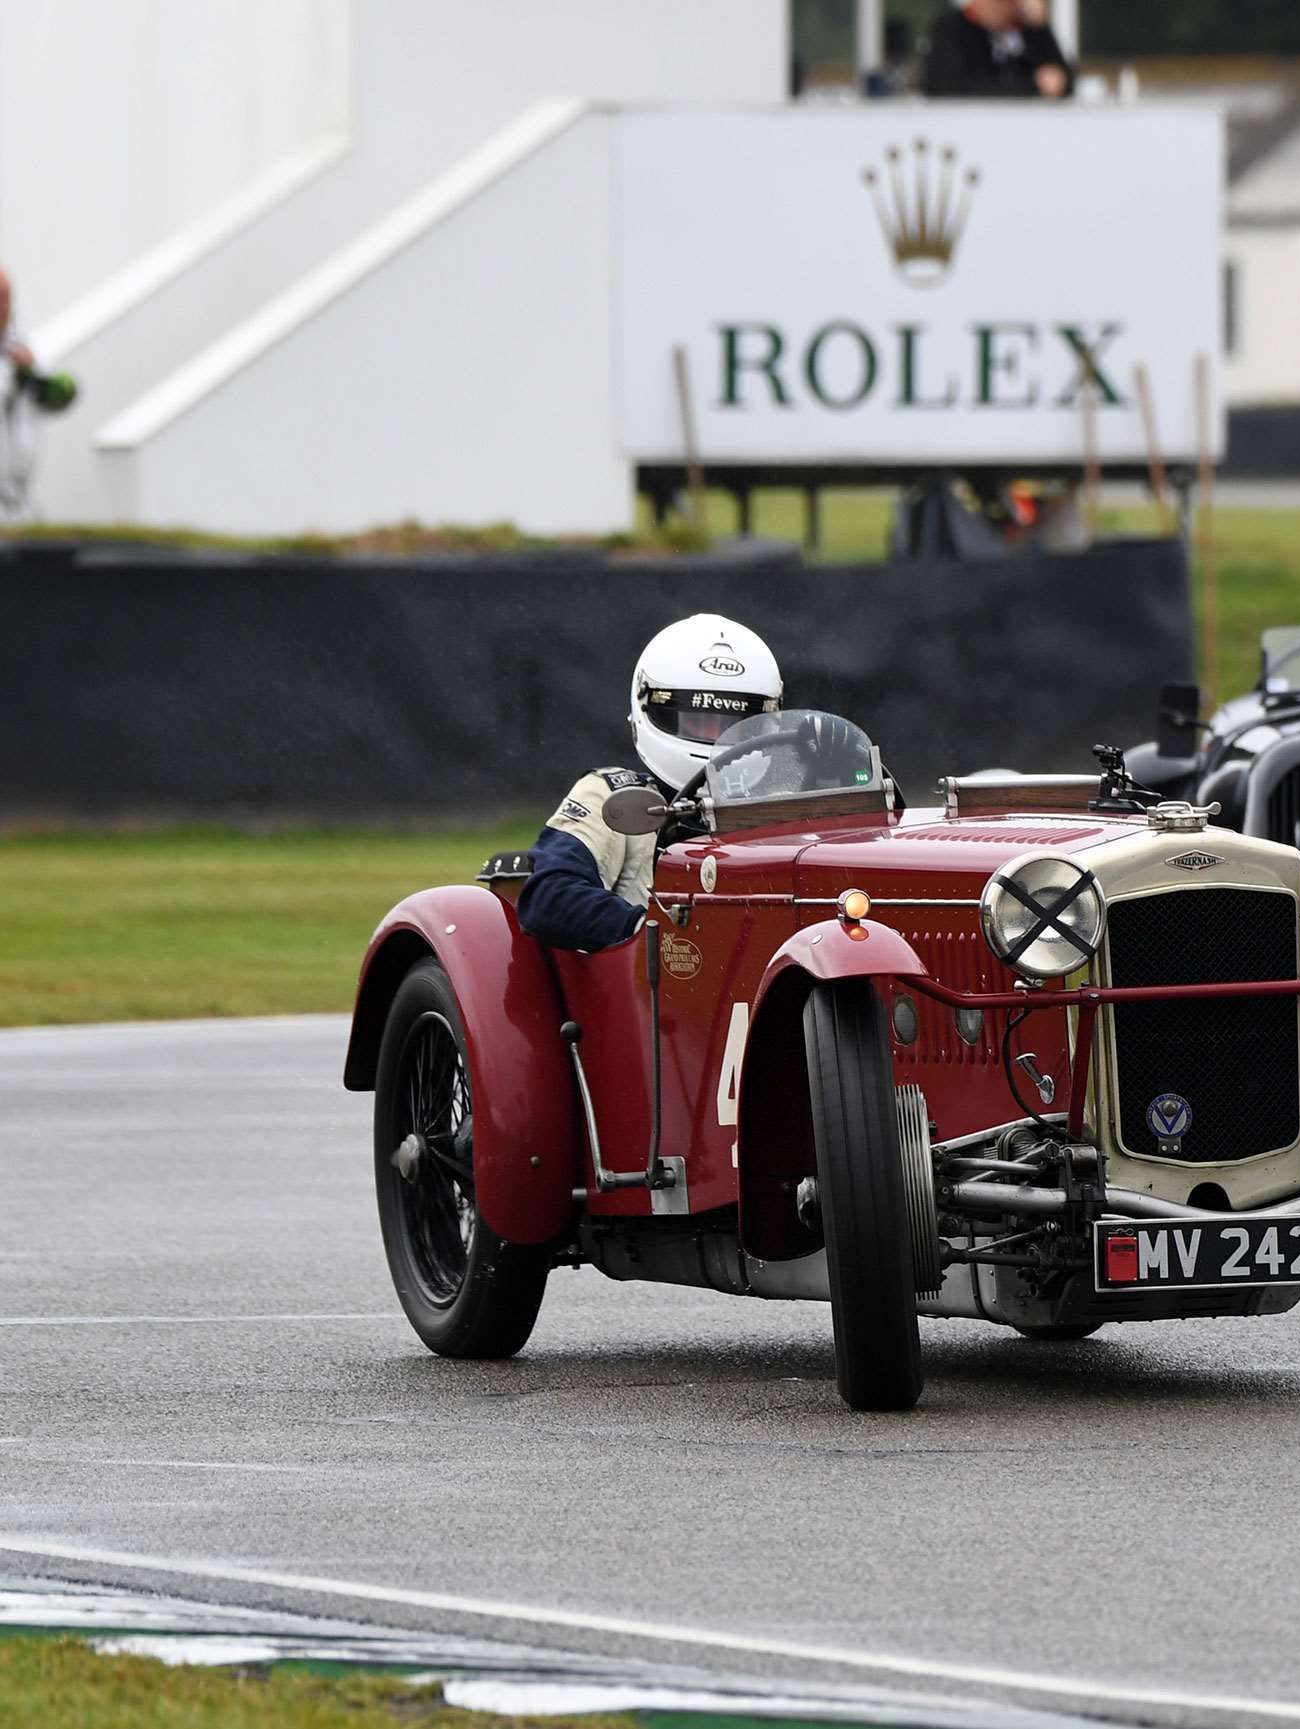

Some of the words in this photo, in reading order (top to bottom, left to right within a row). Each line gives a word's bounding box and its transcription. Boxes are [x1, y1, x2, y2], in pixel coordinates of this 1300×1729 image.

[714, 319, 1128, 411] ROLEX
[706, 658, 740, 673] Arai
[692, 692, 749, 712] #Fever
[562, 802, 588, 818] OMP
[1138, 1229, 1202, 1280] MV
